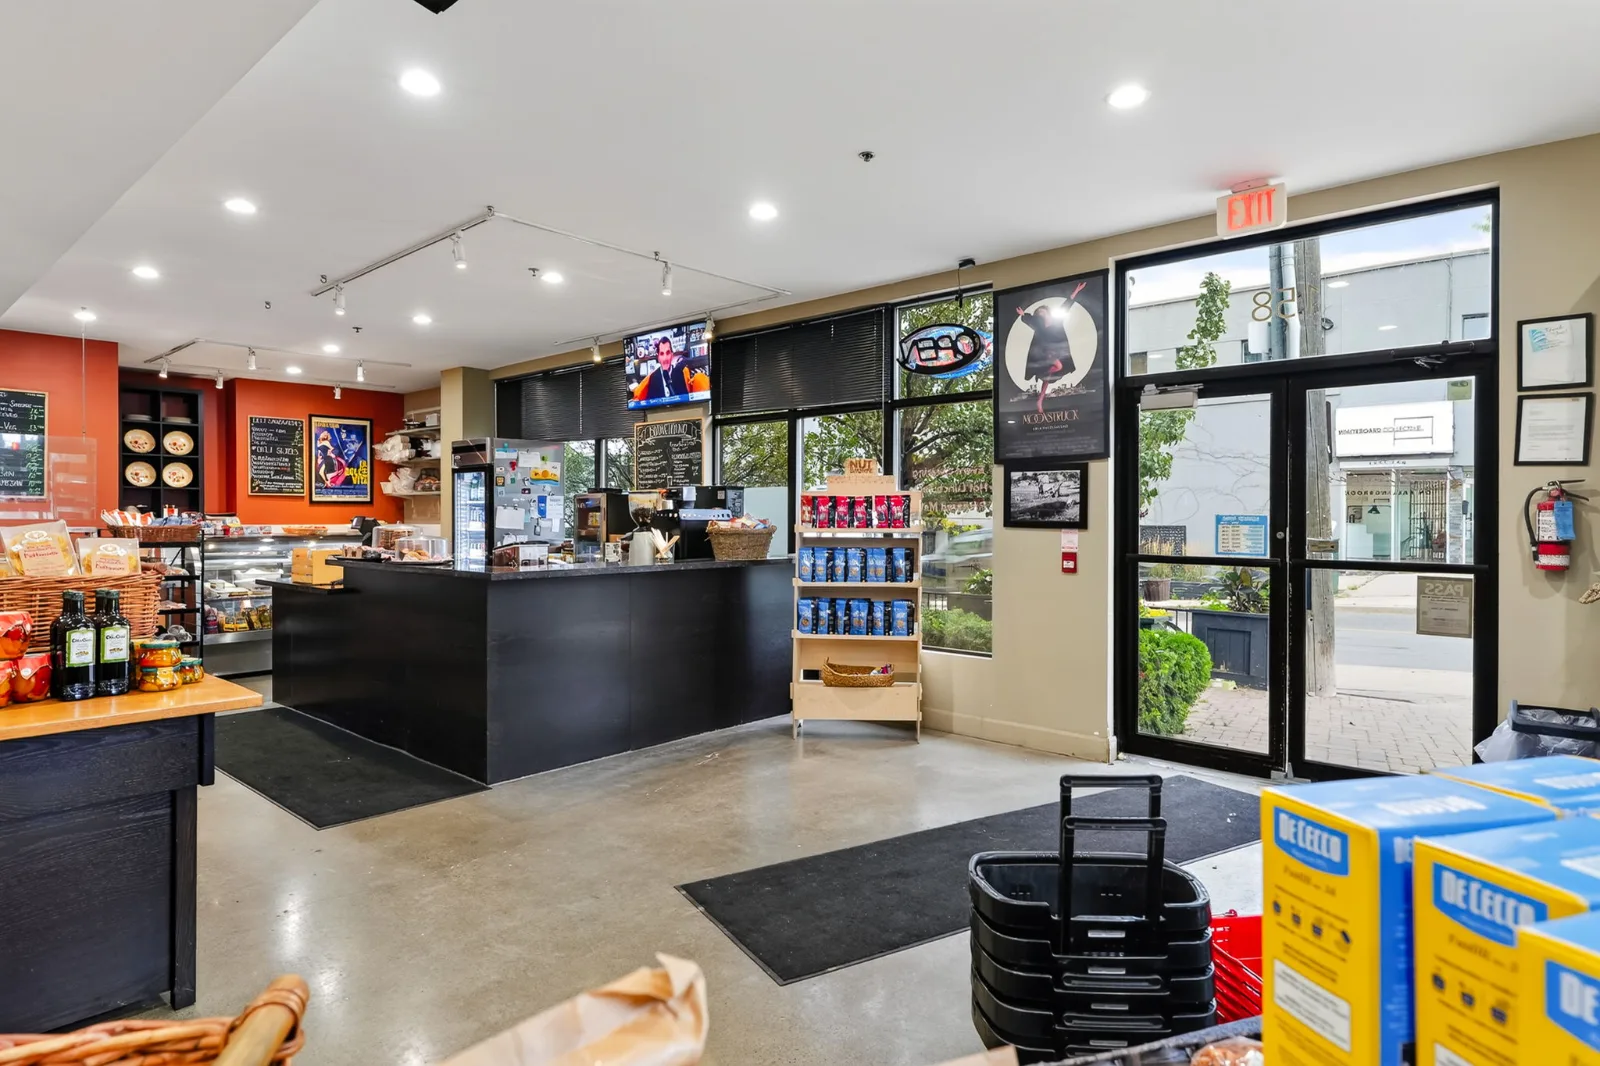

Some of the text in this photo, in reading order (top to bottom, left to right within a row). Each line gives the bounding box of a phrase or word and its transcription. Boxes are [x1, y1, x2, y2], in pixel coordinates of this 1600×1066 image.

[1227, 188, 1276, 231] EXIT
[1023, 409, 1079, 424] MOONSTRUCK
[850, 460, 872, 469] NUT
[1297, 820, 1342, 863] CECCO
[1468, 881, 1535, 928] CECCO
